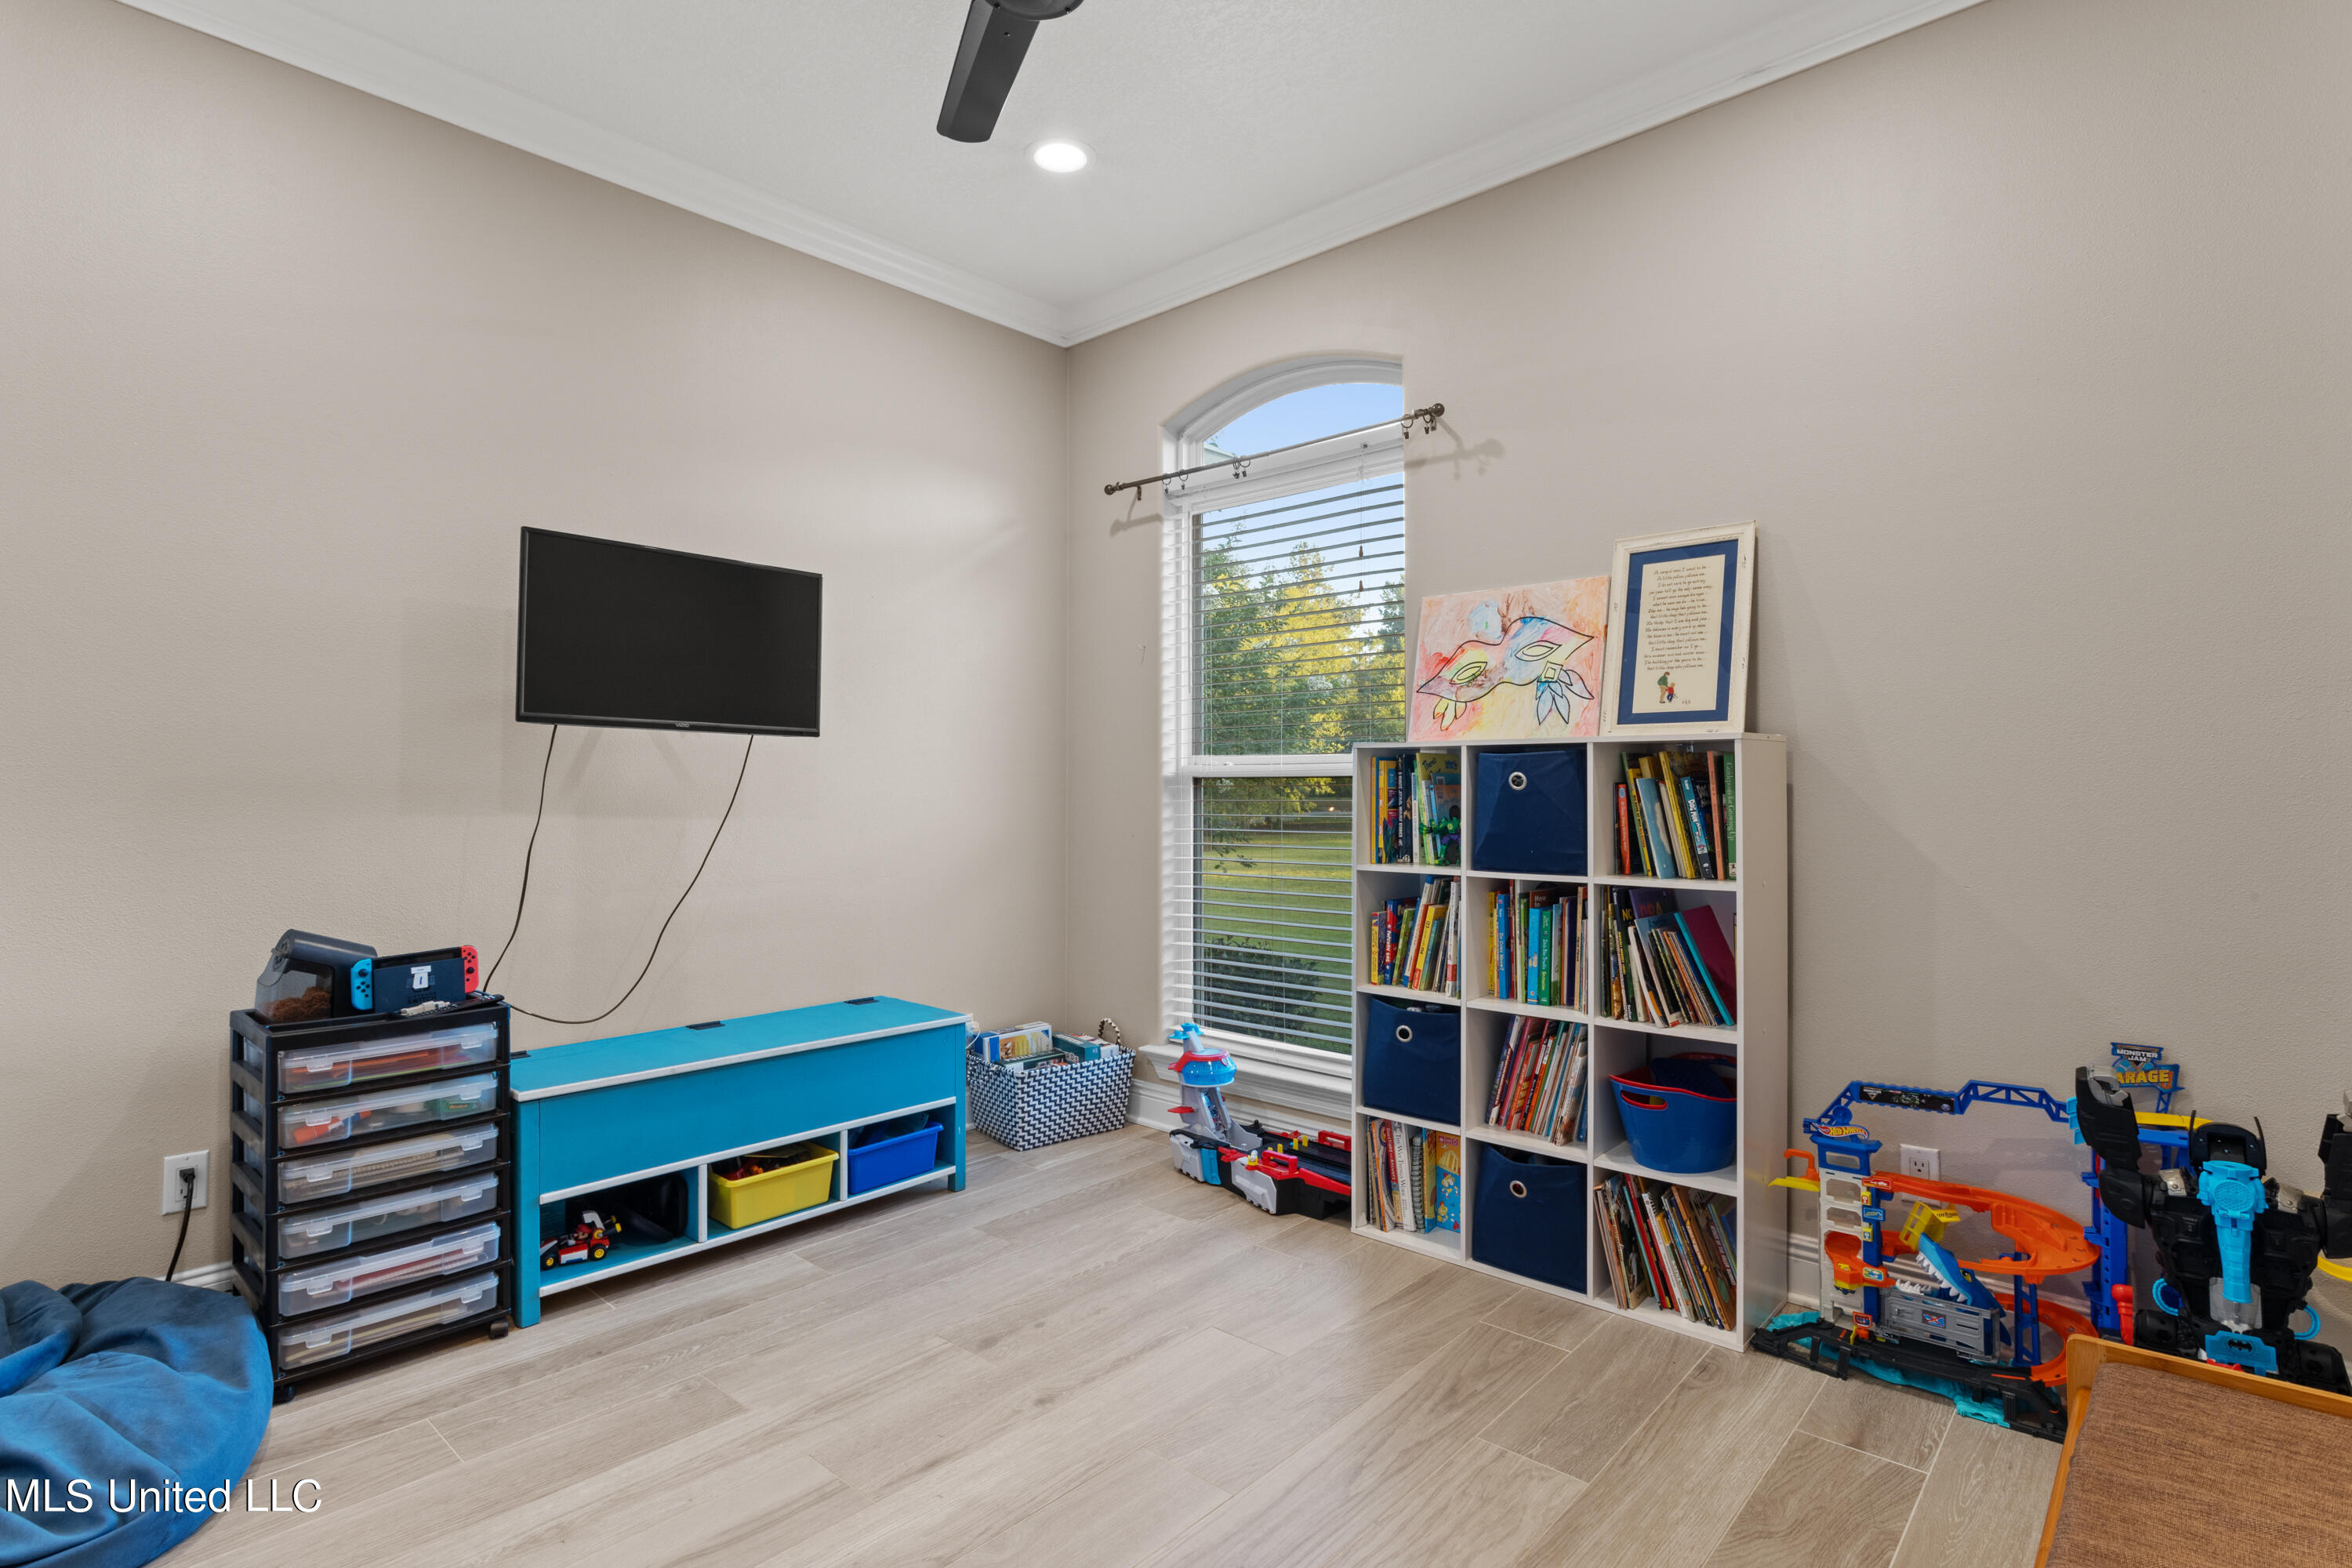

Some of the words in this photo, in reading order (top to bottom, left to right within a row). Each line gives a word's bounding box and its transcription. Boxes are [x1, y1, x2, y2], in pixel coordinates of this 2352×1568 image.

[1687, 799, 1696, 811] DOG
[2117, 1049, 2158, 1058] MONSTER
[2116, 1069, 2170, 1084] ARAGE
[1829, 1127, 1843, 1136] HOT
[1843, 1126, 1865, 1135] WHEELS
